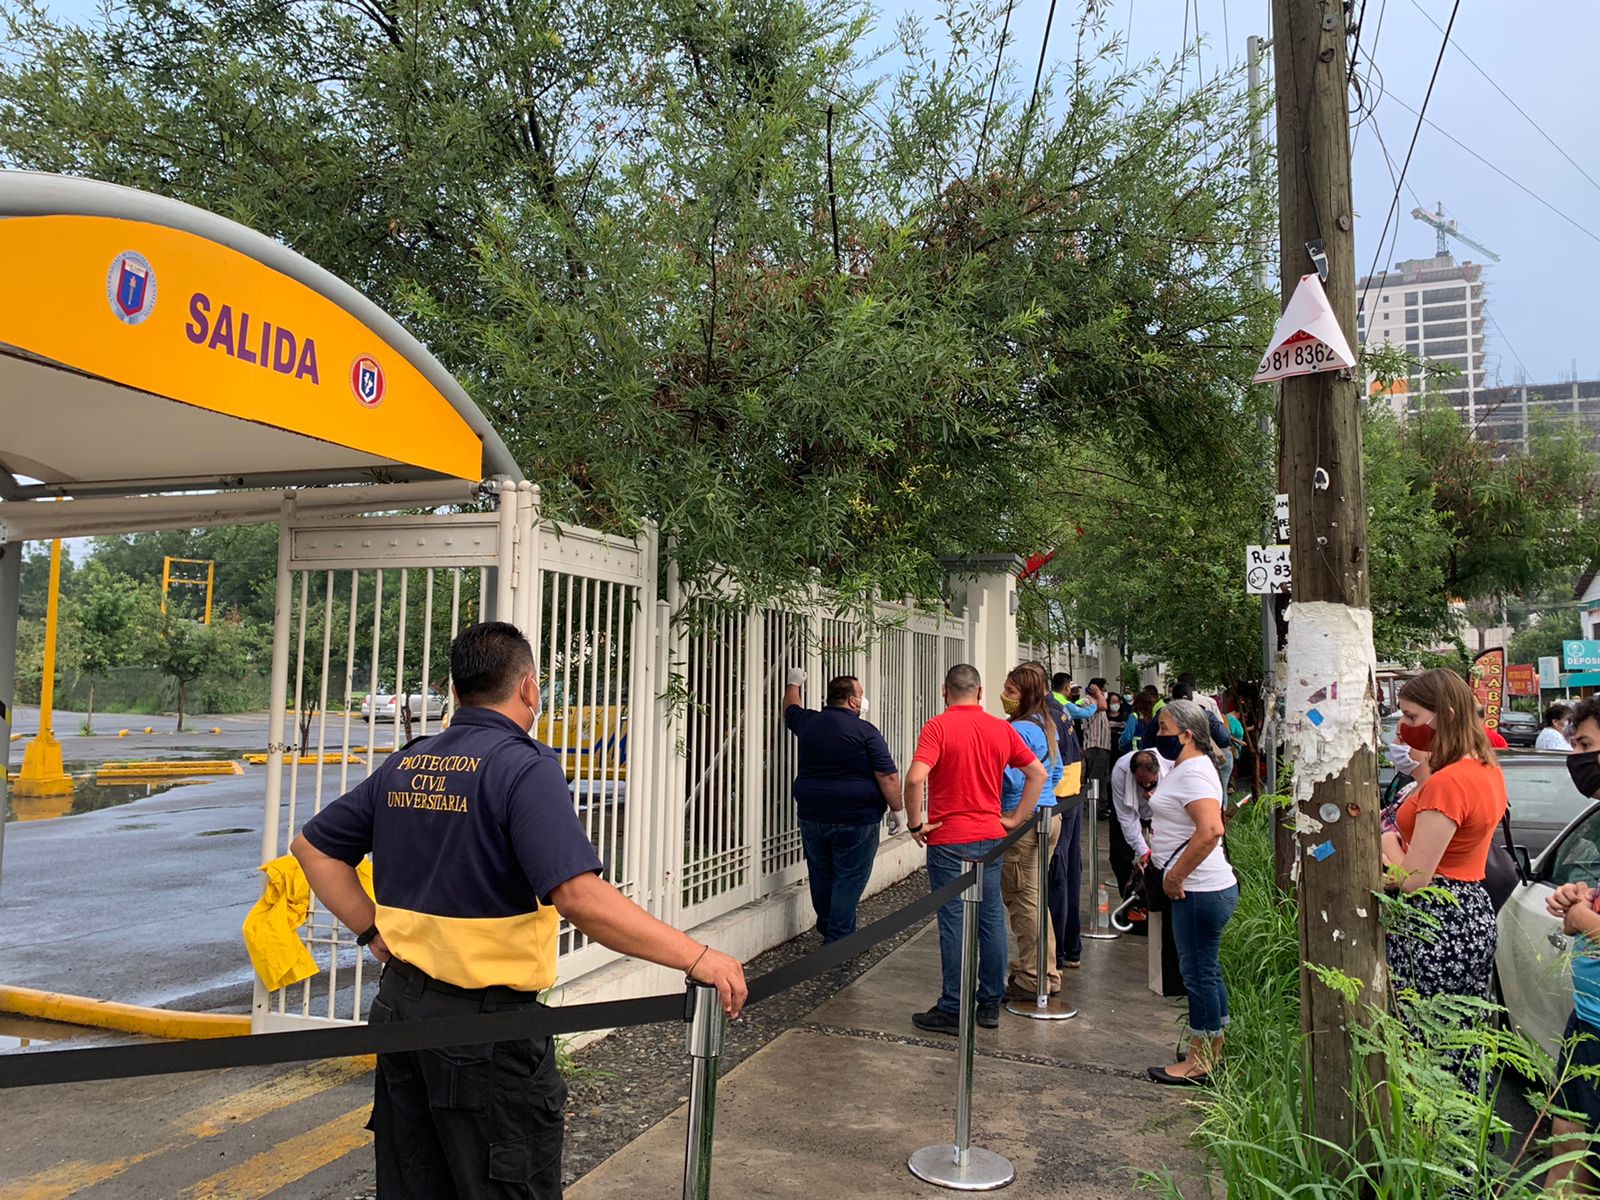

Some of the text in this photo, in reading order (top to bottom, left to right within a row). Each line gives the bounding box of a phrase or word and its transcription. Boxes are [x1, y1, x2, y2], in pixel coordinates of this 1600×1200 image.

[185, 292, 320, 385] SALIDA
[1272, 350, 1289, 371] 81
[411, 774, 446, 791] CIVIL
[387, 792, 468, 812] UNIVERSITARIA
